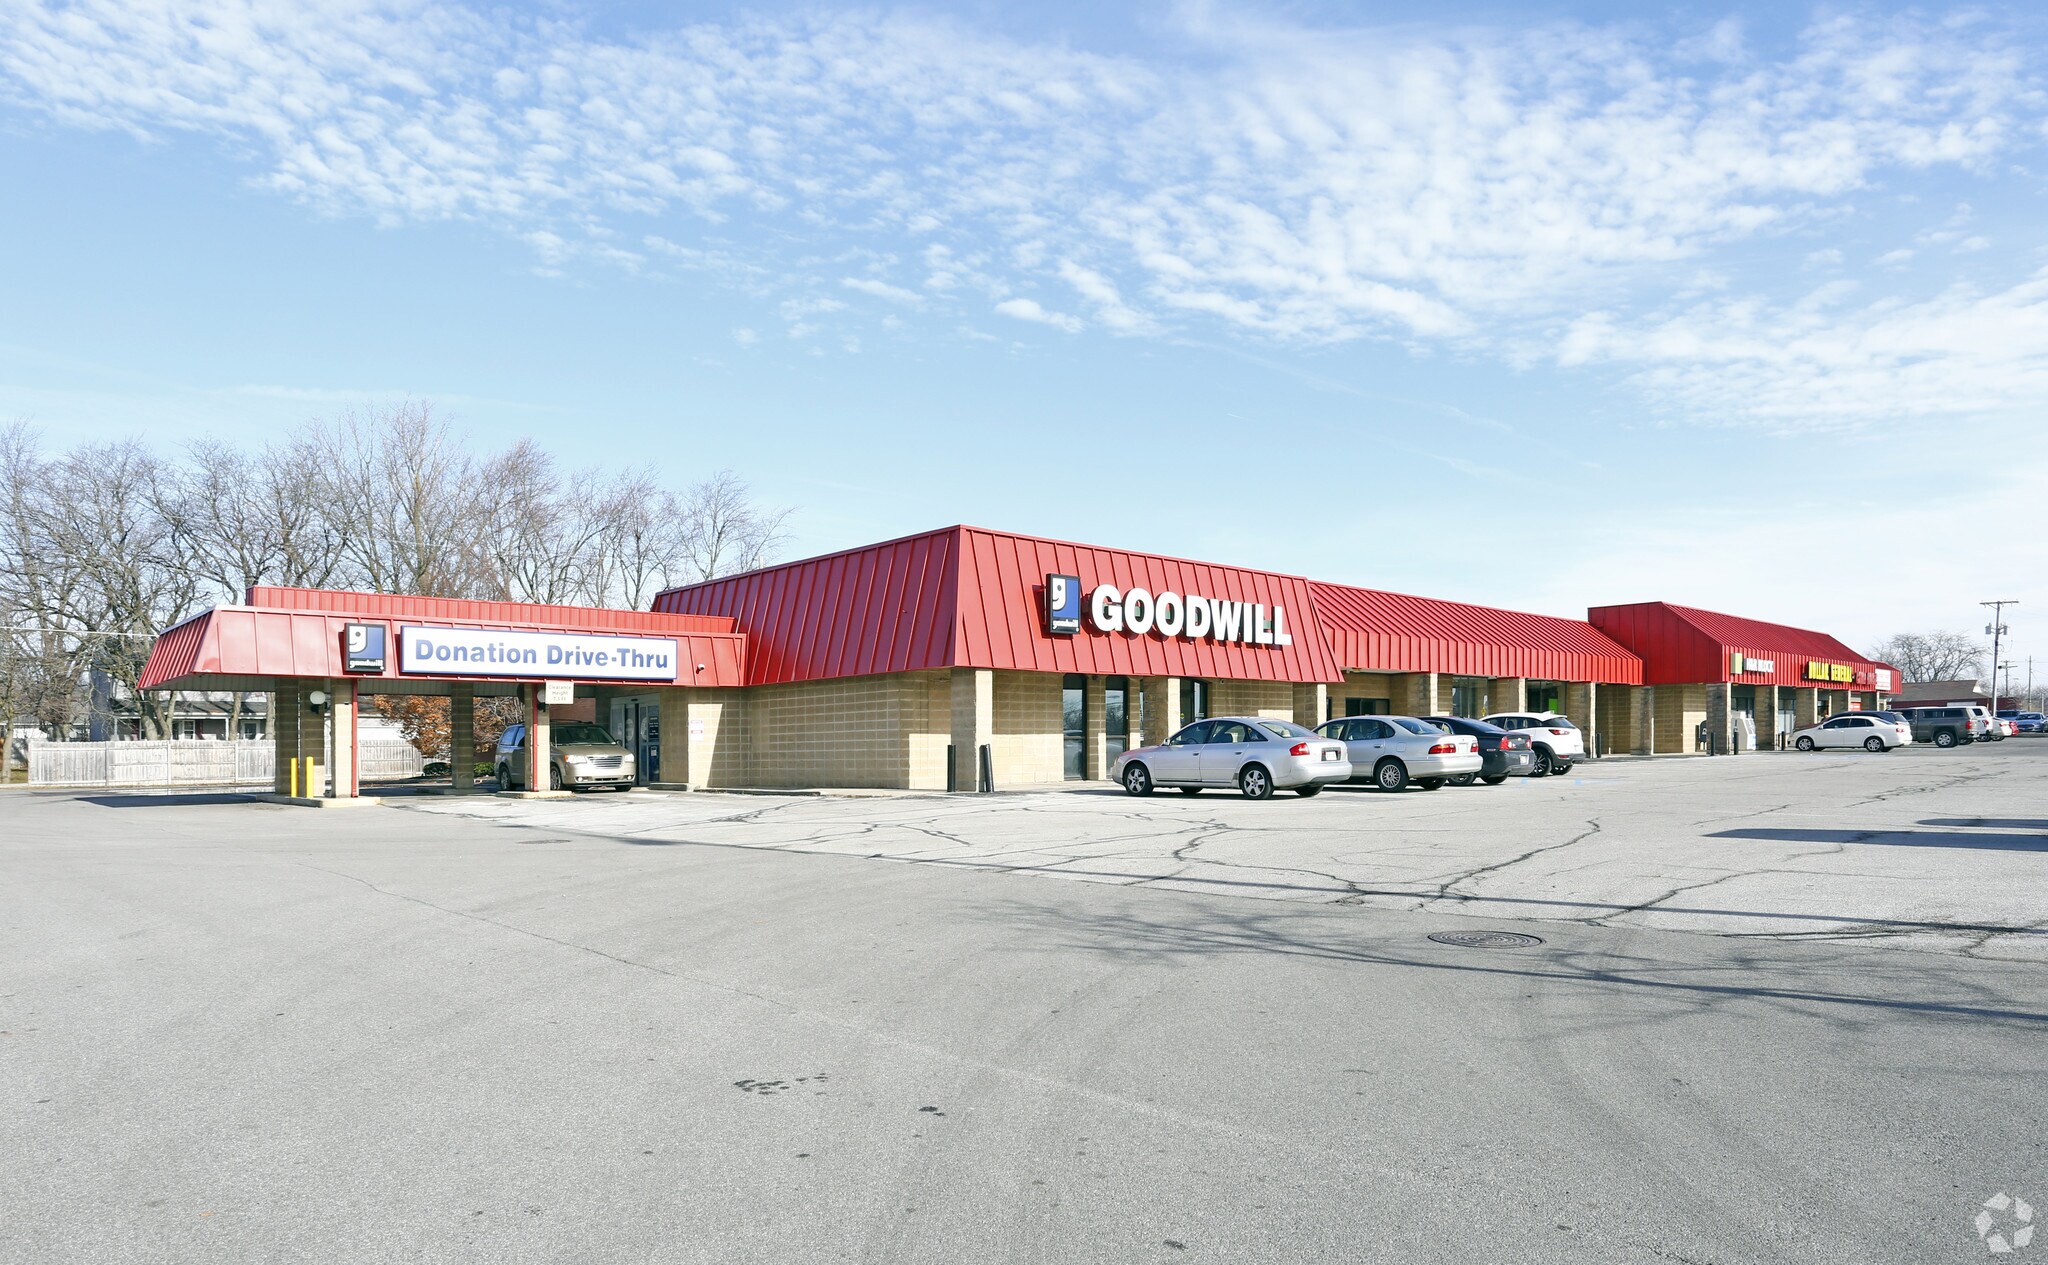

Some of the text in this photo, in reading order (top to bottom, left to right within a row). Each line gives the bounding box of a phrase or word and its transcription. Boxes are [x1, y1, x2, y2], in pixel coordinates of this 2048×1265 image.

[1091, 584, 1292, 645] GOODWILL
[415, 639, 668, 669] Donation Drive-Thru
